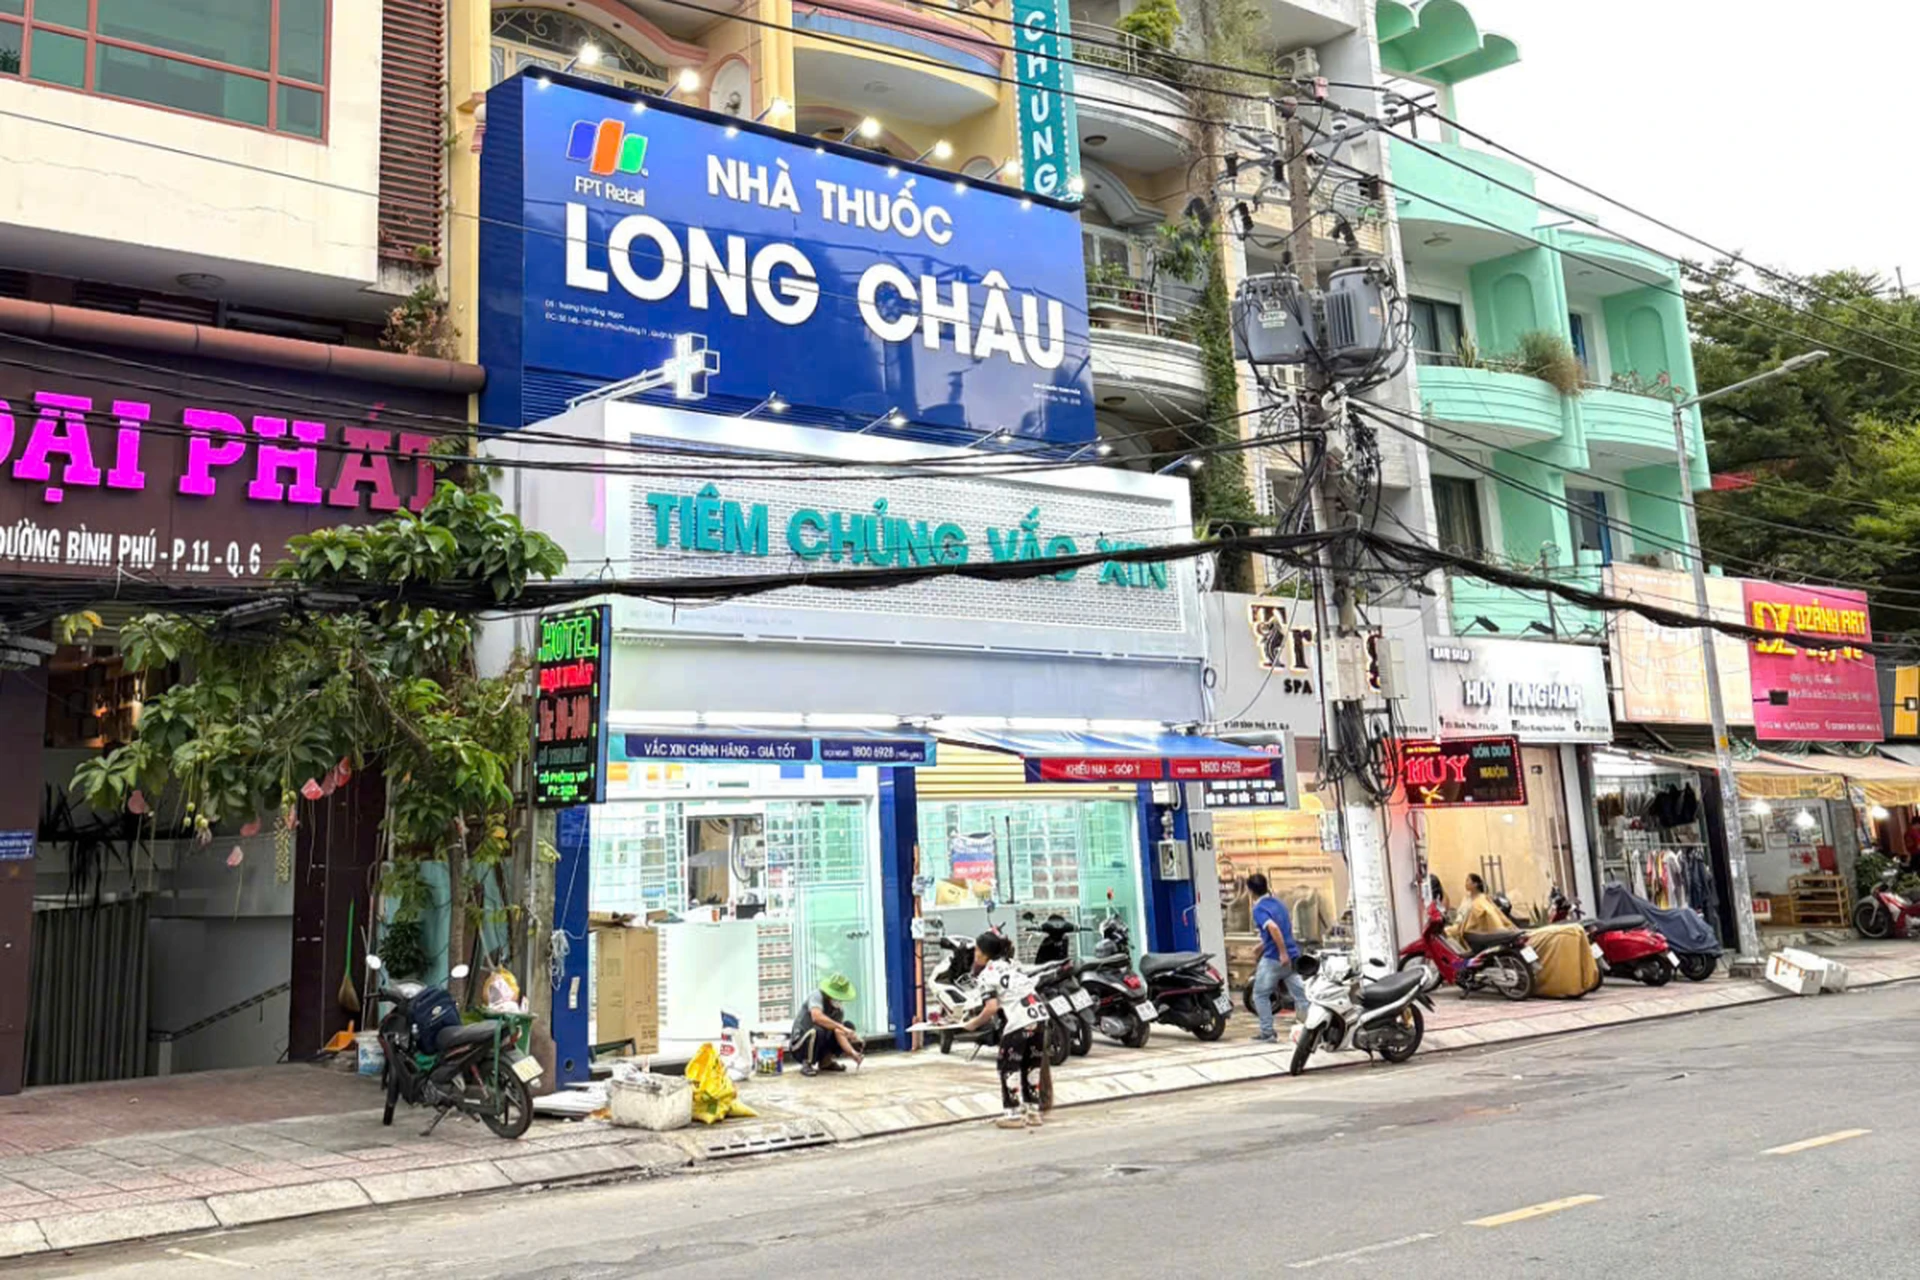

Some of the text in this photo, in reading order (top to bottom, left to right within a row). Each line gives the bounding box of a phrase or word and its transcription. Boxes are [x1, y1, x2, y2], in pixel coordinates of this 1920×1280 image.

[575, 175, 645, 207] FPT Retail
[707, 154, 953, 246] NHÀ THUỐC
[566, 201, 1065, 370] LONG CHÂU
[646, 482, 769, 557] TIÊM
[786, 497, 968, 567] CHỦNG
[66, 523, 112, 566] BÌNH
[117, 528, 156, 568] PHÚ
[250, 543, 261, 574] 6
[1840, 610, 1866, 635] ART
[541, 617, 594, 662] HOTEL
[1283, 678, 1313, 696] SPA
[644, 738, 668, 756] VẮC
[669, 743, 687, 756] XIN
[688, 741, 720, 758] CHÍNH
[720, 742, 750, 758] HÃNG
[757, 742, 776, 758] GIÁ
[776, 742, 797, 759] TỐT
[852, 745, 873, 758] 1800
[873, 746, 895, 759] 6928
[1065, 760, 1090, 775] KHIẾU
[1091, 763, 1107, 778] NẠI
[1113, 761, 1133, 775] GÓP
[1200, 761, 1220, 773] 1800
[1221, 761, 1241, 773] 6928
[1406, 754, 1469, 784] HUY
[1193, 831, 1213, 851] 149
